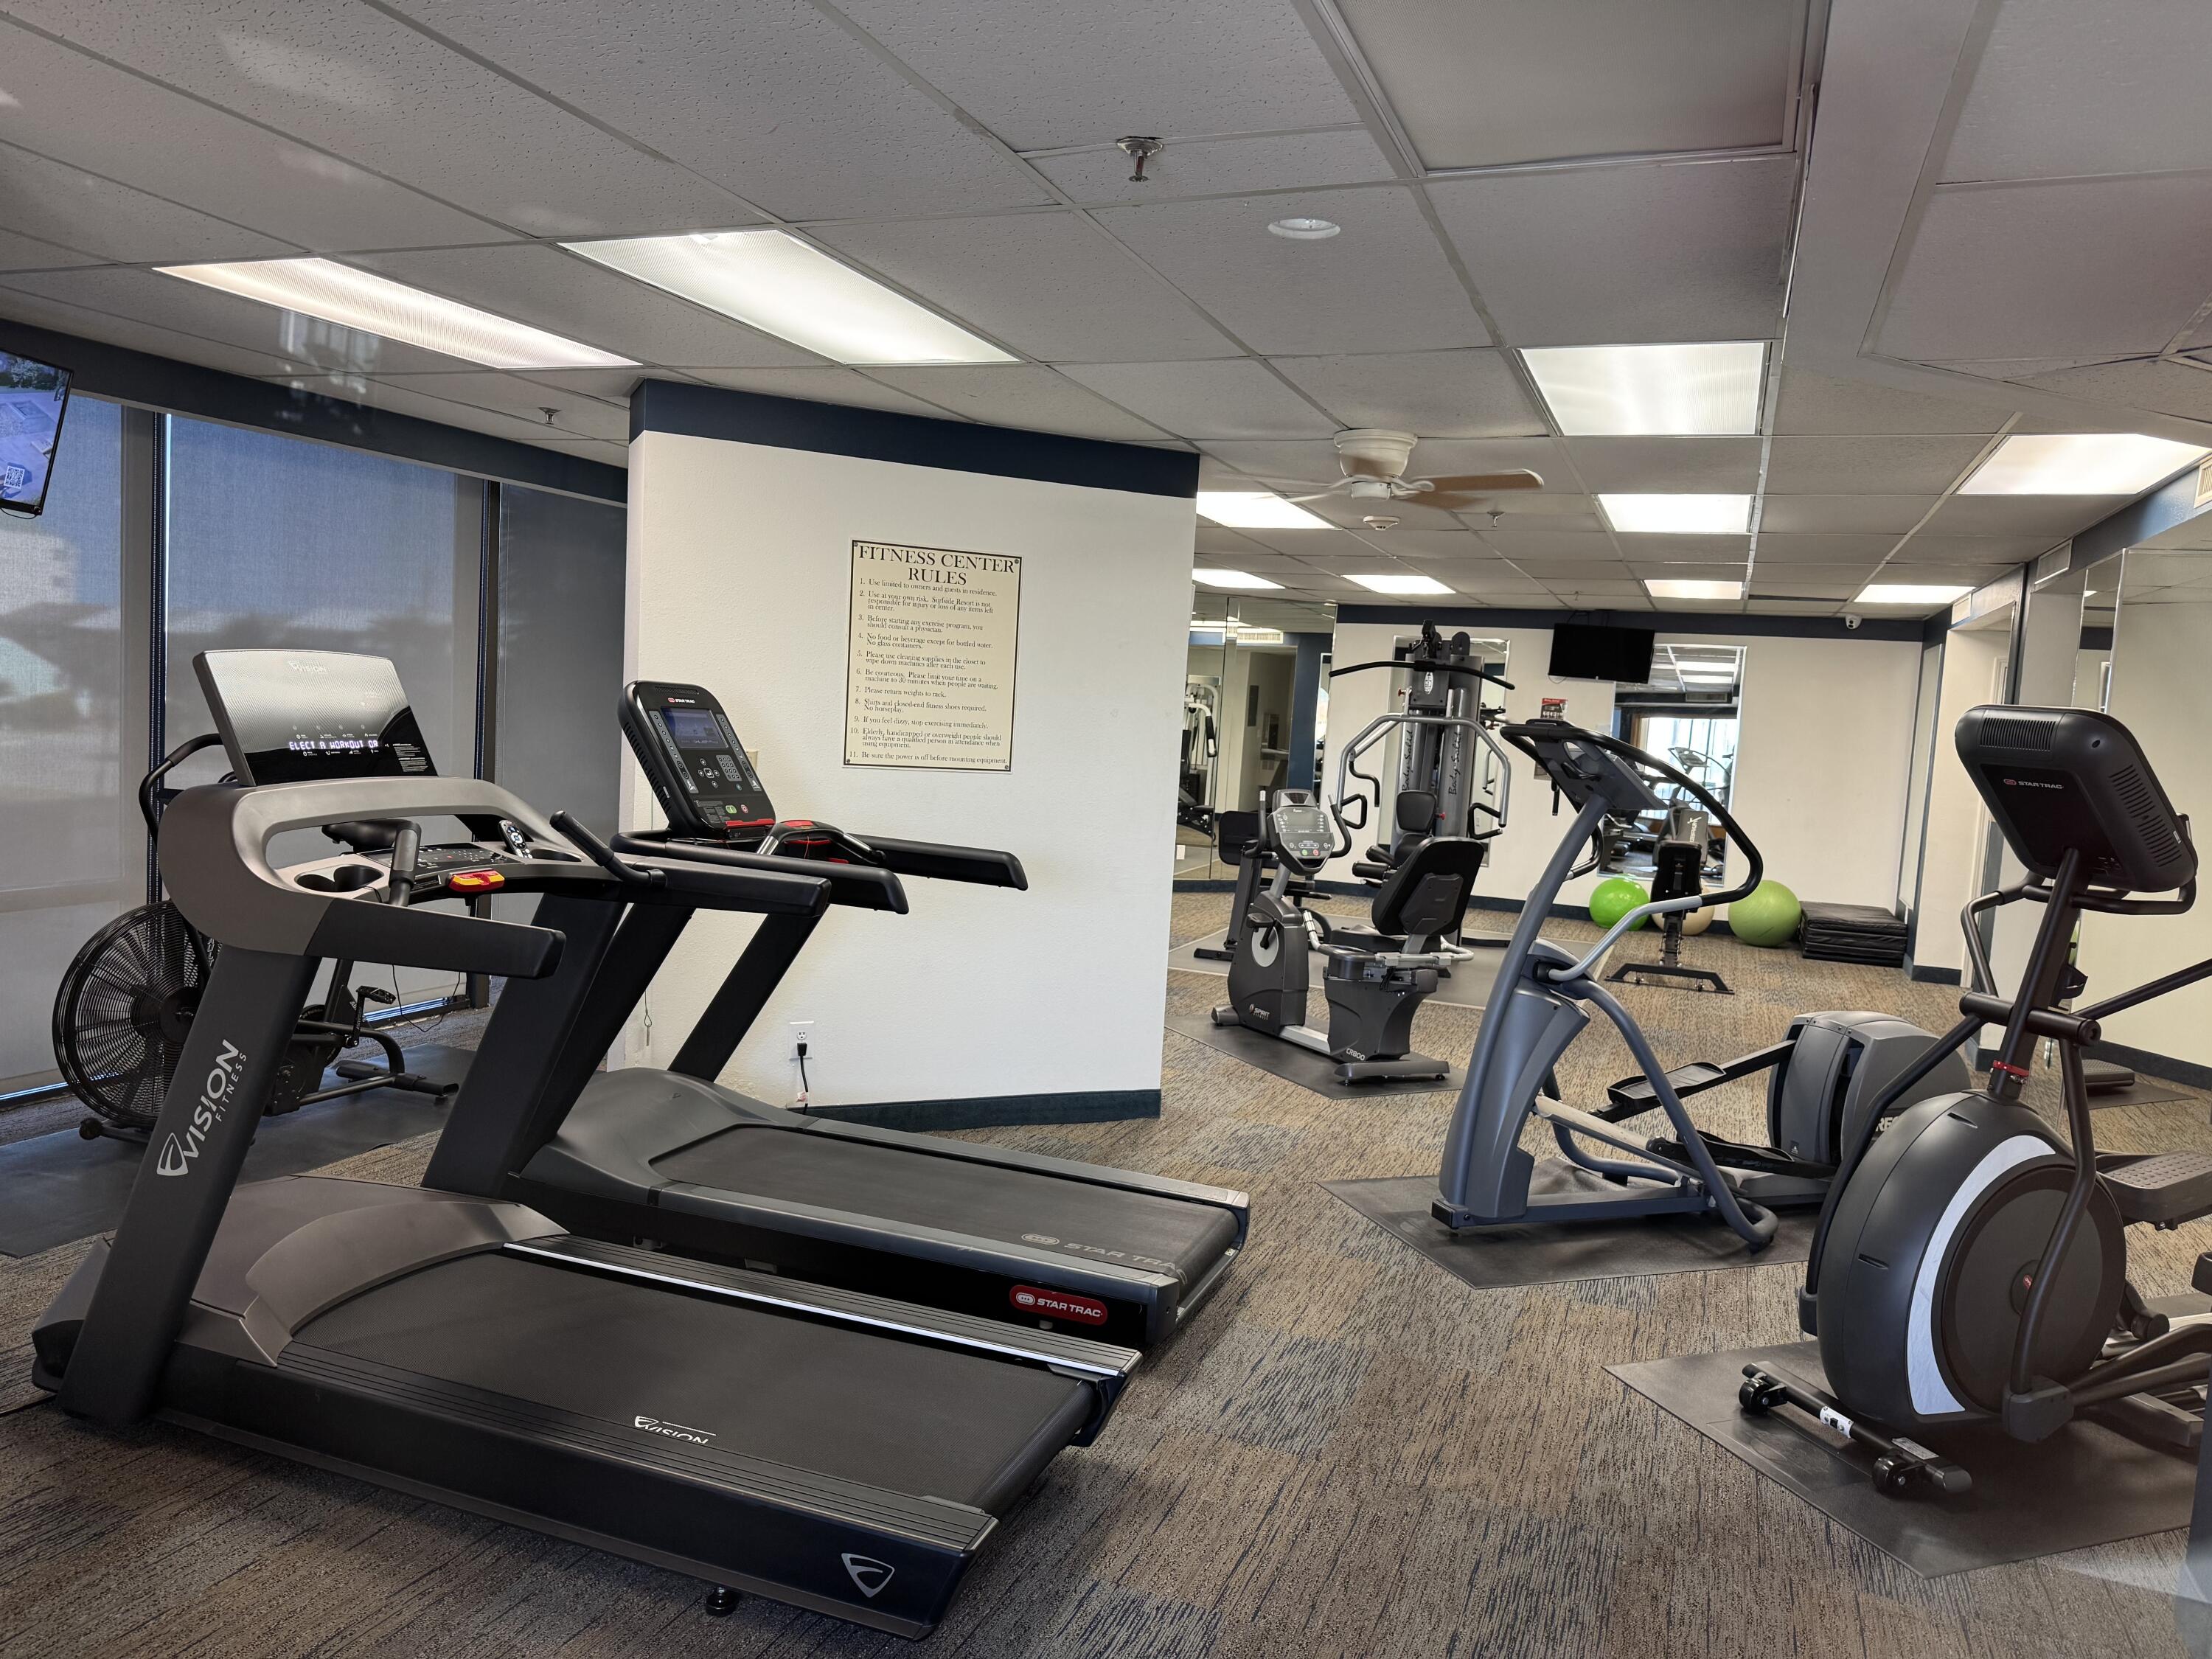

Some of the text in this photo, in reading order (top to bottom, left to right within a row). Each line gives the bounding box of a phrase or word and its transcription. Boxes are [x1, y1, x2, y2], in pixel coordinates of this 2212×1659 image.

[859, 545, 1014, 574] FITNESS CENTER
[908, 567, 967, 585] RULES
[944, 586, 961, 594] guests
[969, 588, 997, 596] residence.
[868, 597, 900, 607] responsible
[888, 616, 909, 625] starting
[915, 625, 942, 634] physician.
[877, 639, 890, 648] glass
[900, 636, 925, 644] beverage
[866, 657, 879, 665] wipe
[897, 653, 920, 662] cleaning
[922, 655, 944, 664] supplies
[947, 680, 965, 688] people
[903, 689, 923, 698] weights
[961, 703, 987, 712] required.
[862, 734, 880, 742] always
[863, 728, 885, 737] Elderly,
[932, 731, 961, 740] overweight
[288, 740, 316, 750] ELECT
[329, 740, 364, 749] WORKOUT
[878, 740, 911, 749] equipment.
[976, 757, 1006, 765] equipment.
[1346, 1047, 1366, 1061] CR800
[215, 1052, 247, 1121] FITNESS
[184, 1039, 239, 1158] VISION
[1064, 1242, 1125, 1258] STAR
[1037, 1298, 1102, 1317] STAR TRAC
